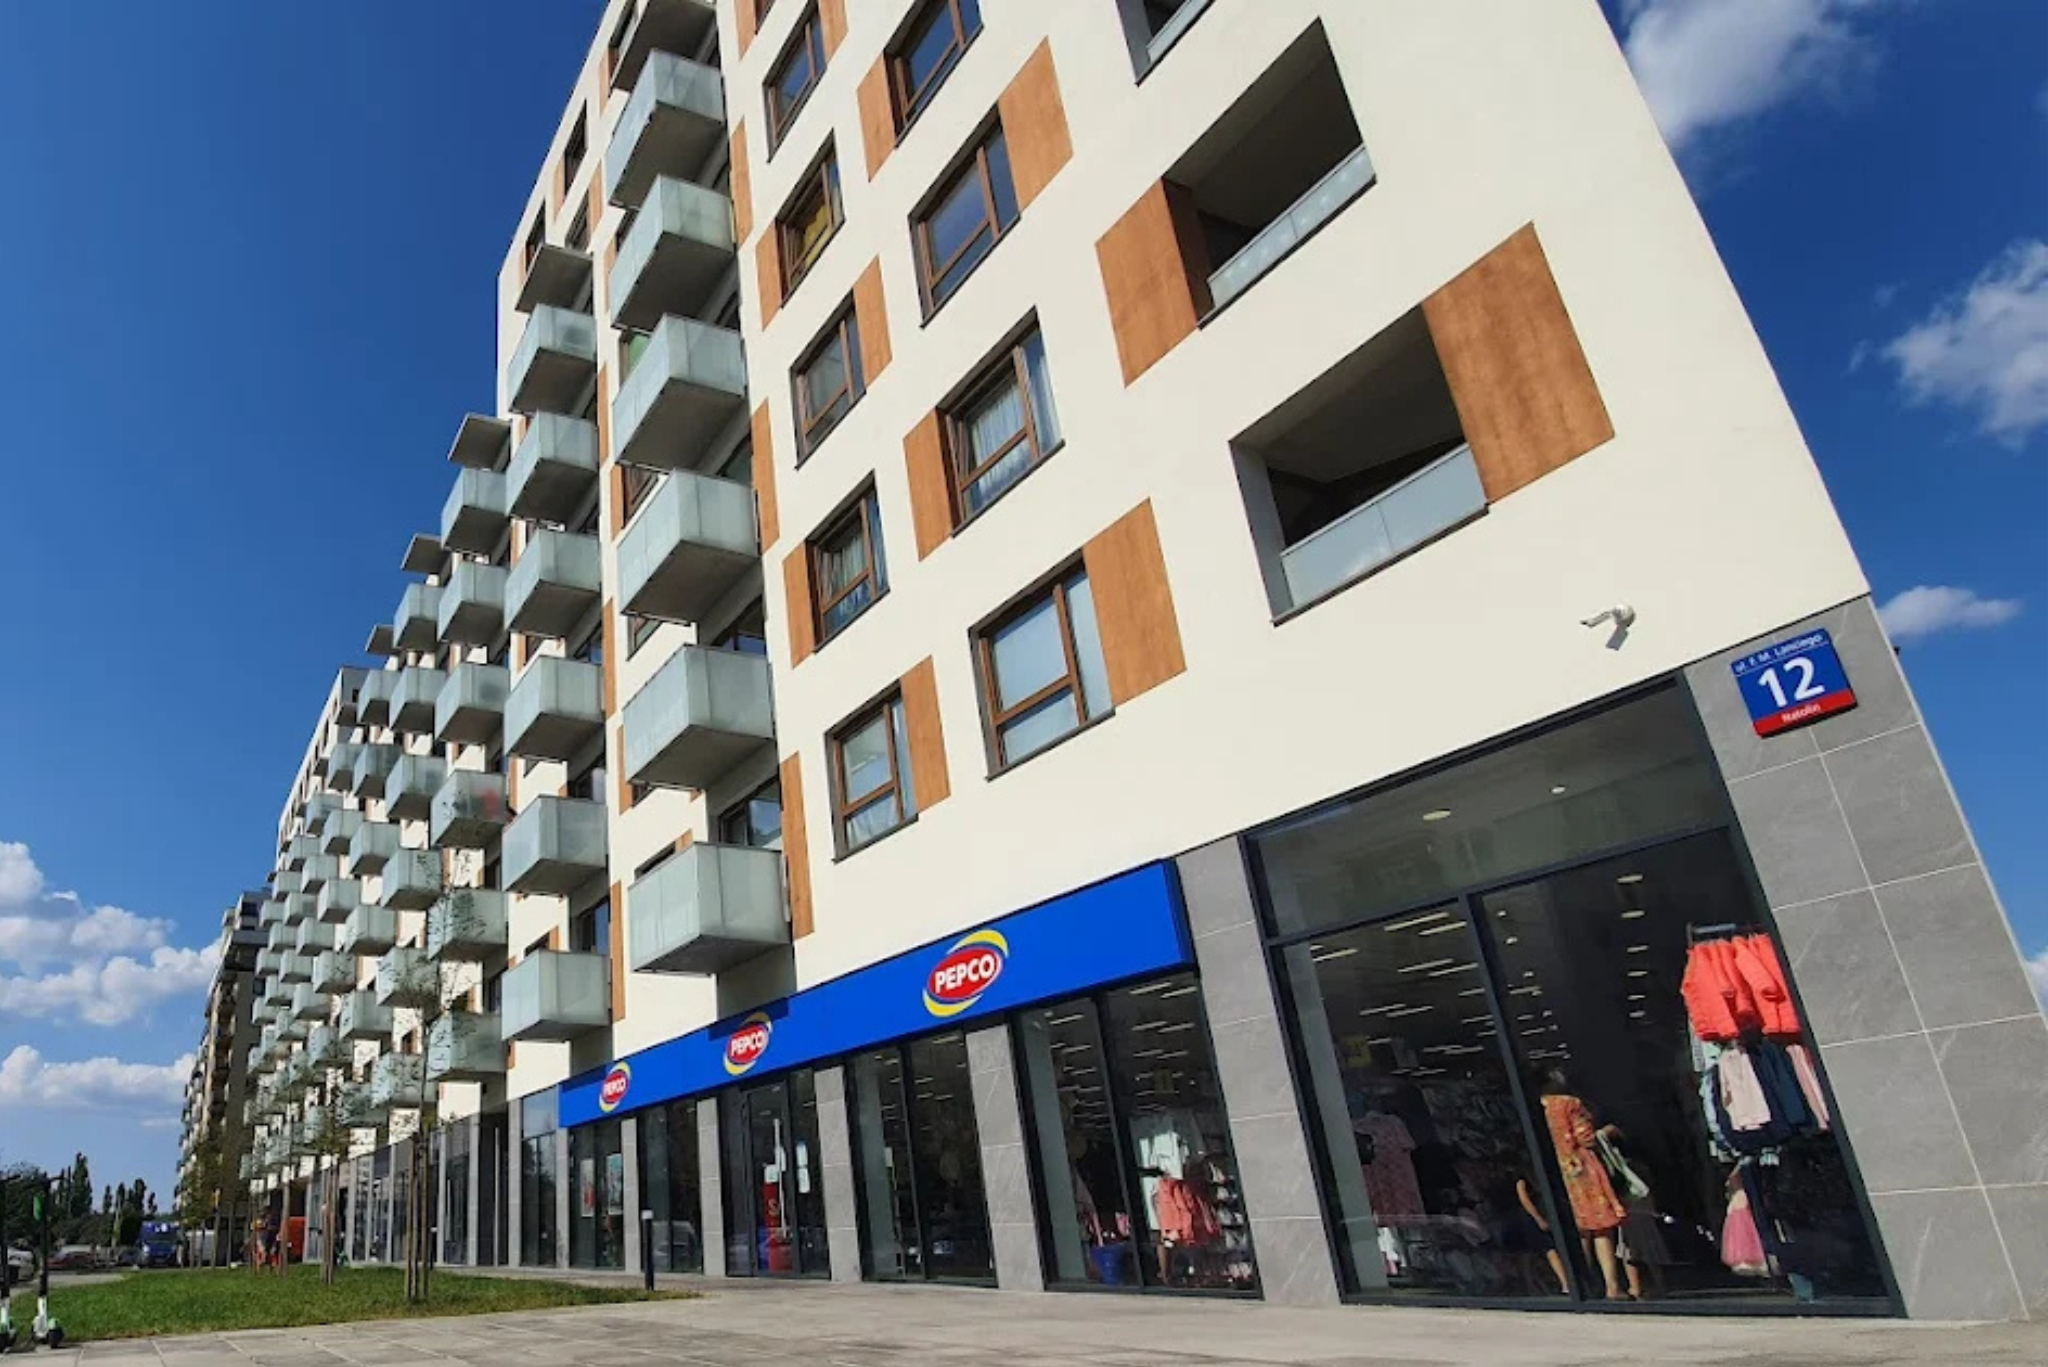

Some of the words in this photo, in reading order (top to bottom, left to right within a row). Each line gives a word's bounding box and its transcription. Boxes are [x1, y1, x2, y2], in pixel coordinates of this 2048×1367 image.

[1758, 656, 1826, 708] 12
[1781, 703, 1821, 723] Natolin
[934, 953, 995, 994] PEPCO
[731, 1031, 766, 1056] PEPCO
[603, 1077, 626, 1096] PEPCO
